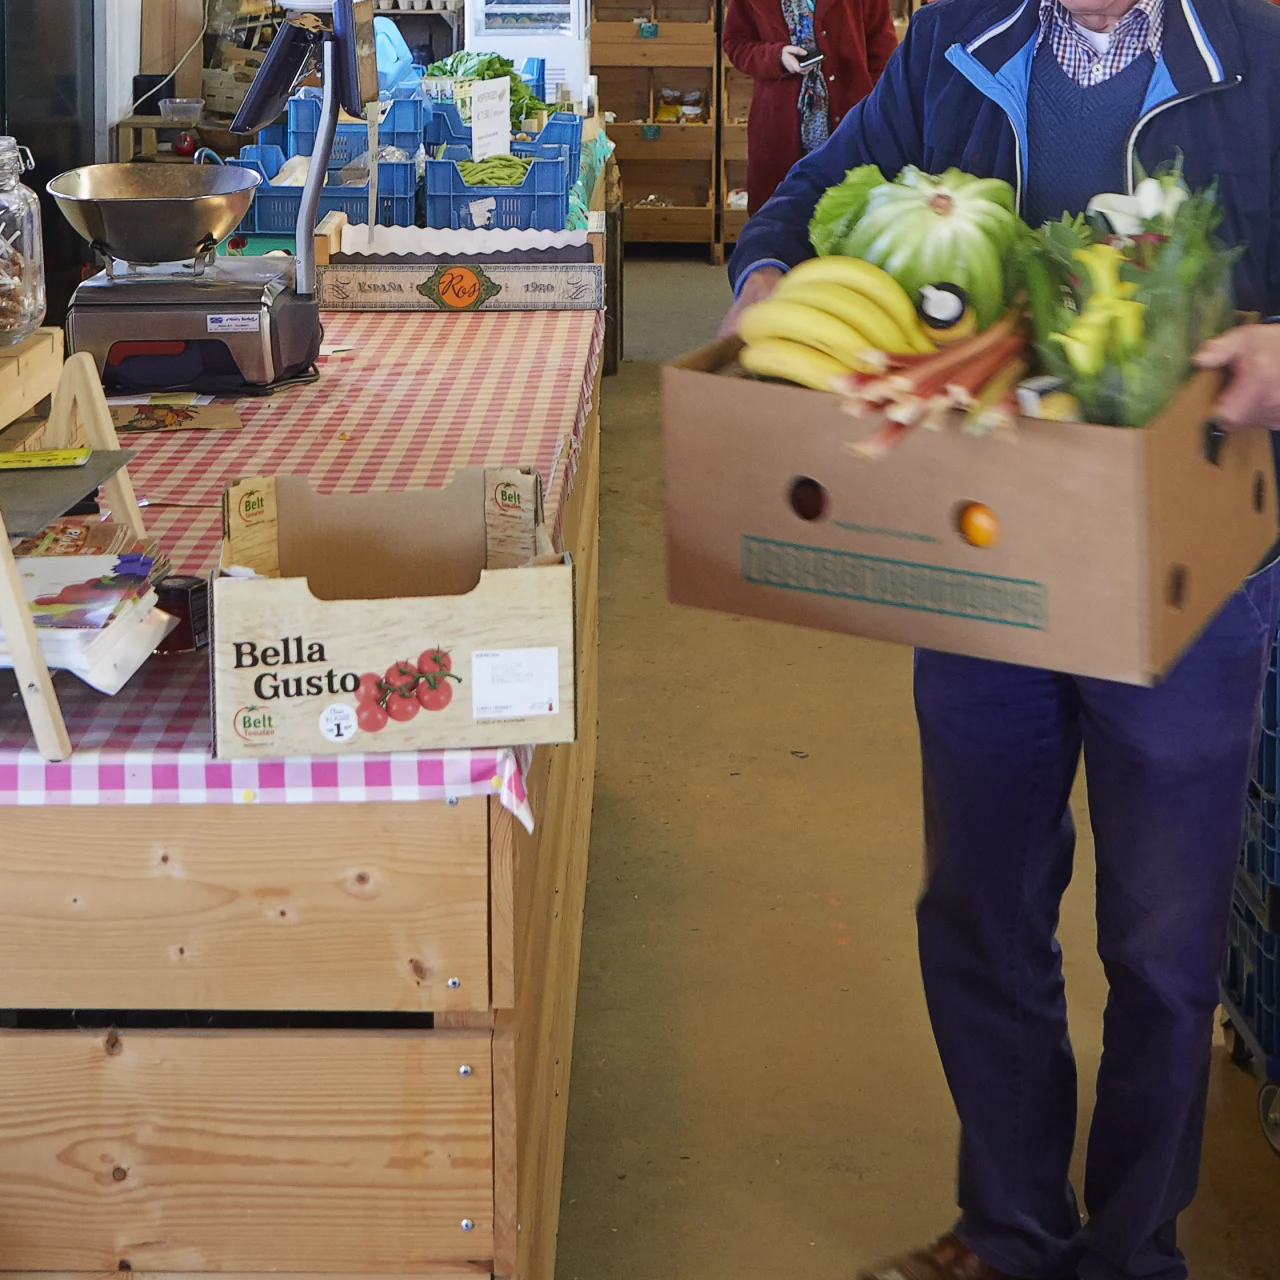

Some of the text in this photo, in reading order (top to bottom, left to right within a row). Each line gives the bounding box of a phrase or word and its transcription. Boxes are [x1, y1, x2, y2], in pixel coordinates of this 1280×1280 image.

[439, 272, 481, 299] Ros
[243, 496, 264, 512] Belt
[500, 489, 521, 504] Belt
[232, 635, 328, 669] Bella
[253, 668, 361, 701] Gusto
[242, 714, 273, 729] Belt
[334, 722, 344, 737] 1
